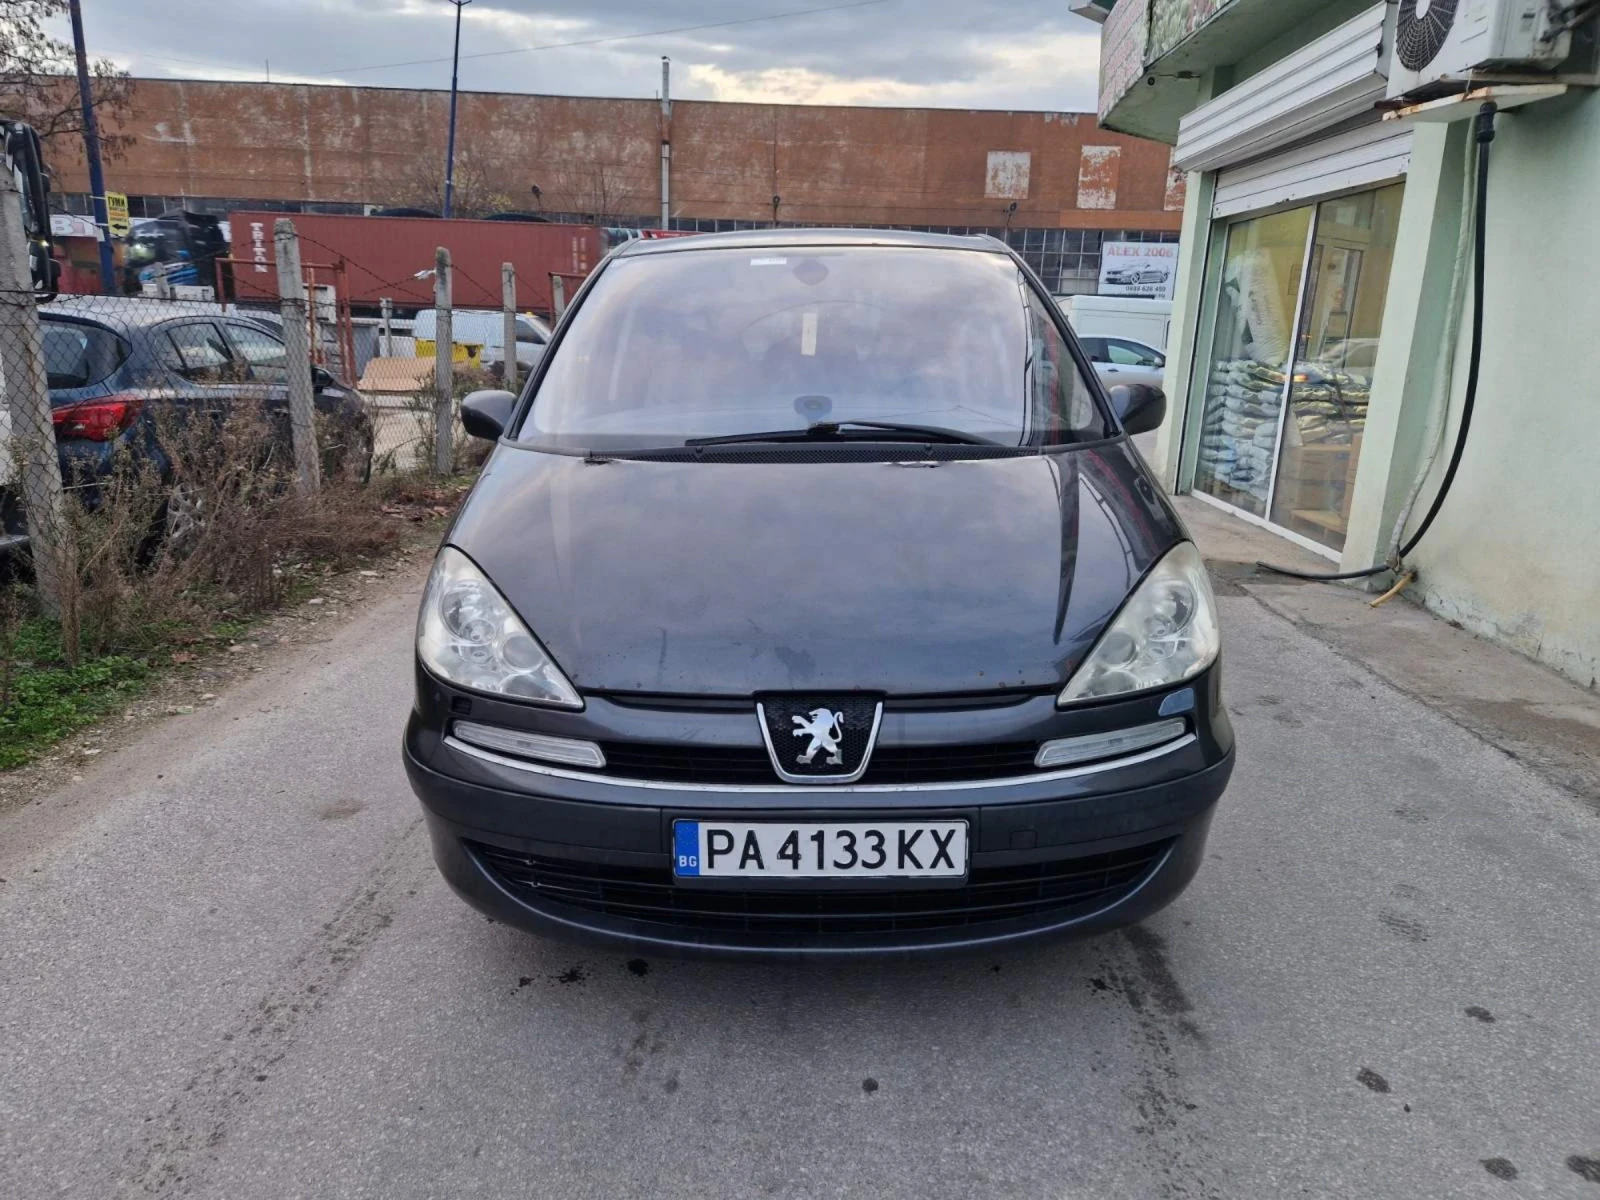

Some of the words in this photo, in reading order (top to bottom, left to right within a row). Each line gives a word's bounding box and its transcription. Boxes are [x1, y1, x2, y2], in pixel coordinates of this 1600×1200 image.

[250, 222, 268, 273] TRITON
[1107, 245, 1140, 257] ALEX
[678, 855, 698, 868] BG
